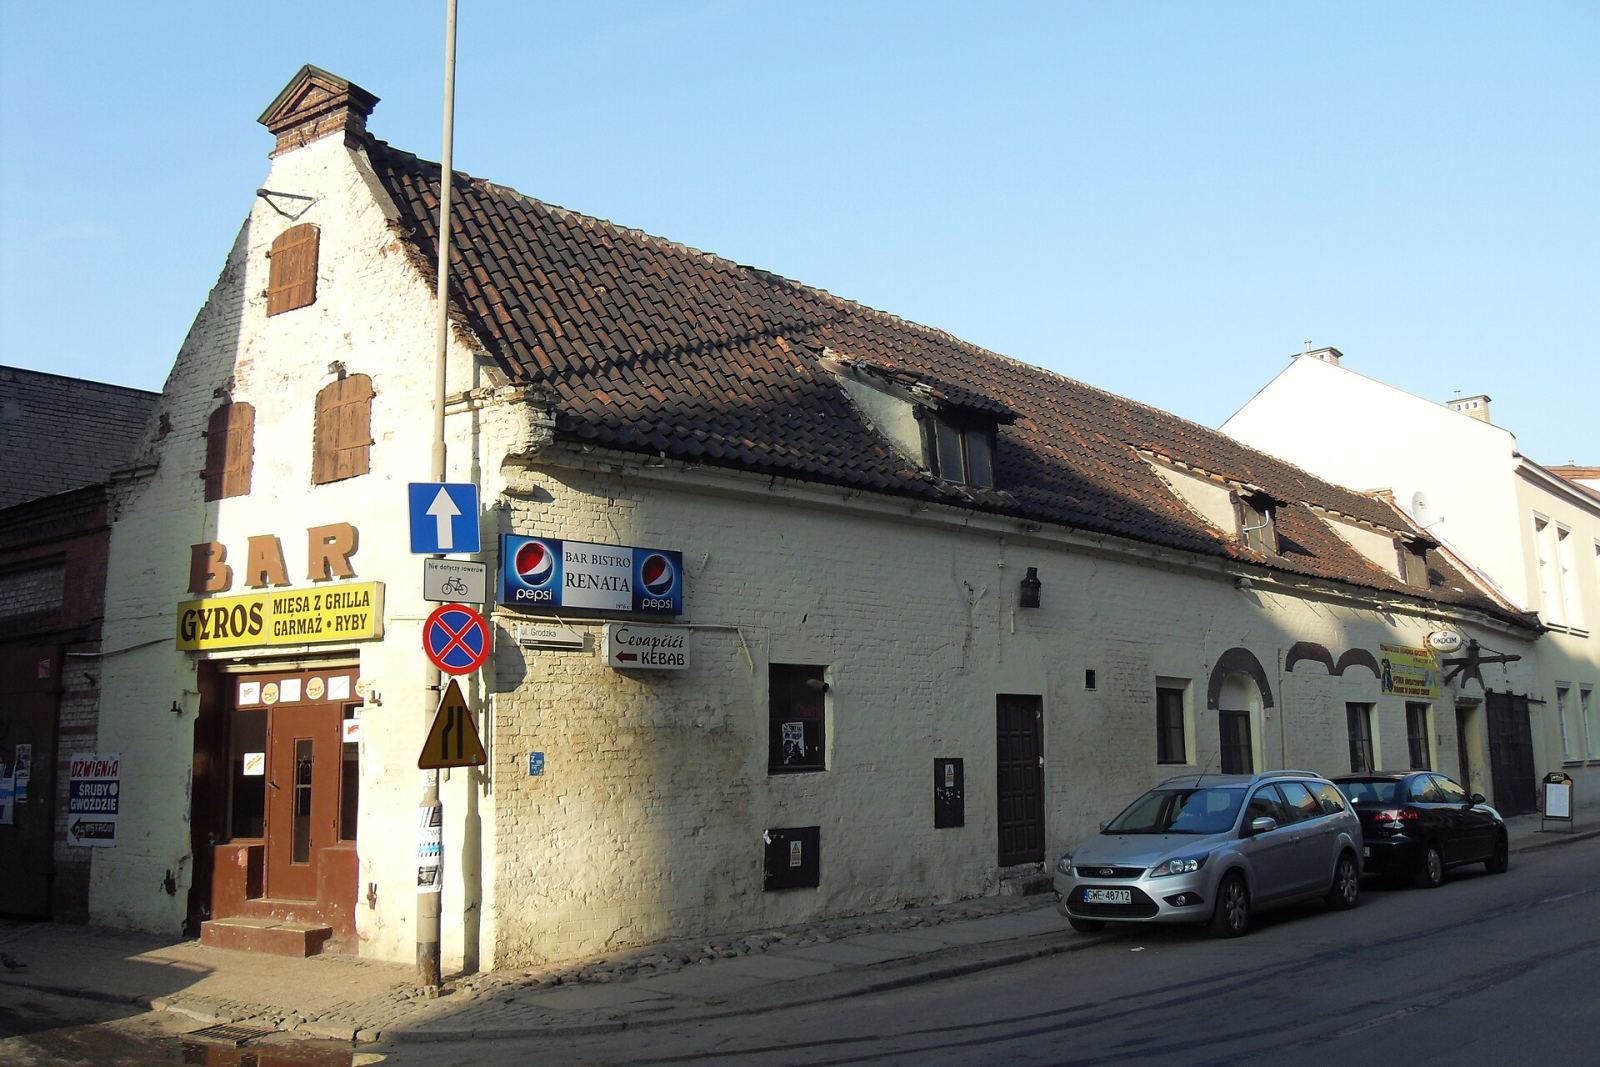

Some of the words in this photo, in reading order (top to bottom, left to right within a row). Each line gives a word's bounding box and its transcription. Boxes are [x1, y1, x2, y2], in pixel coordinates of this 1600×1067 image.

[187, 522, 358, 594] BAR
[566, 552, 587, 564] BAR
[592, 555, 631, 568] BISTRO
[565, 572, 631, 592] RENATA
[516, 588, 552, 601] pepsi
[273, 596, 310, 618] MIĘSA
[314, 595, 322, 610] Z
[326, 591, 370, 610] GRILLA
[642, 598, 673, 611] pepsi
[181, 602, 264, 642] GYROS
[274, 613, 322, 636] GARMAŻ
[336, 614, 368, 632] RYBY
[530, 628, 556, 638] Grodzka
[642, 652, 685, 666] KEBAB
[80, 782, 109, 796] ŚRUBY
[1088, 890, 1102, 900] GWE
[1106, 890, 1130, 900] 48712
